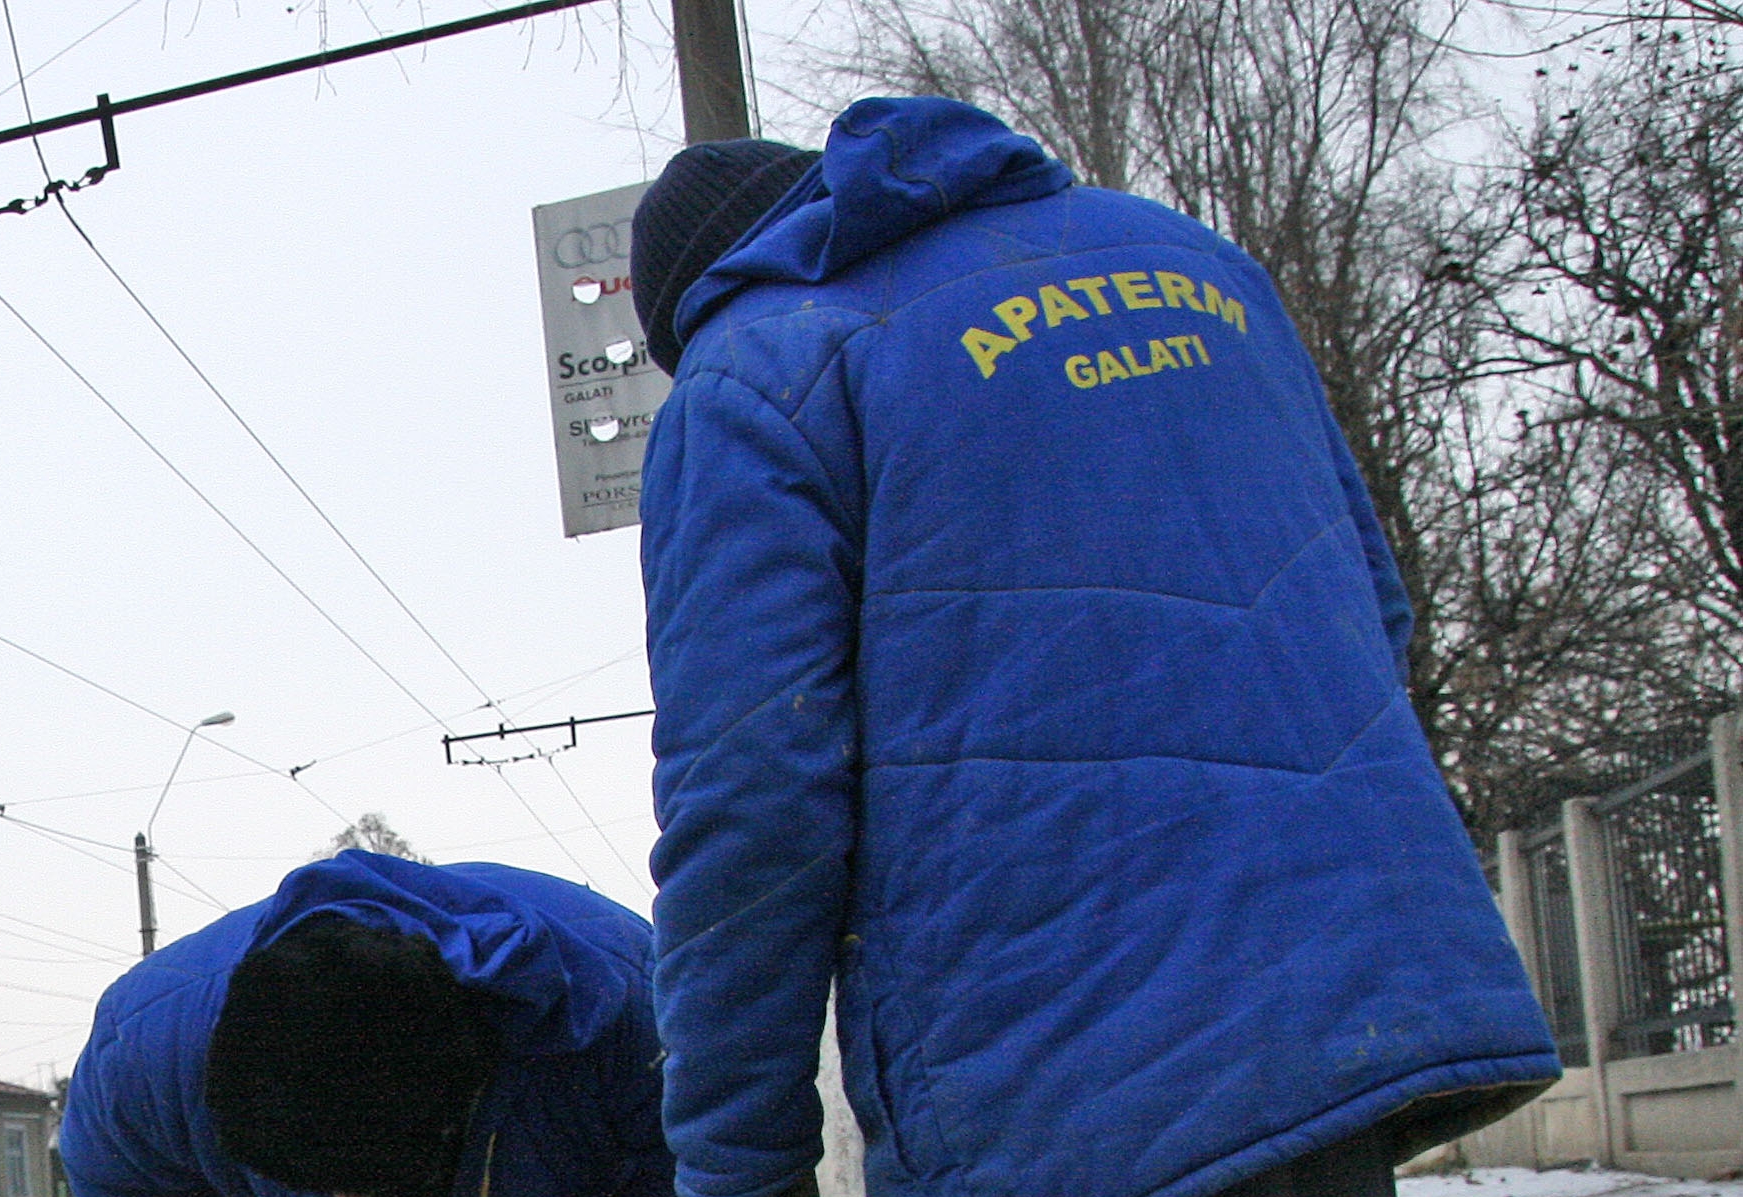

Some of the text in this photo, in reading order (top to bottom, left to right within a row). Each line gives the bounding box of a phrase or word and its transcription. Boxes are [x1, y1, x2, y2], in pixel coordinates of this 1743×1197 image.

[960, 270, 1248, 380] APATERM
[558, 340, 648, 380] Scopi
[1064, 334, 1212, 389] GALATI
